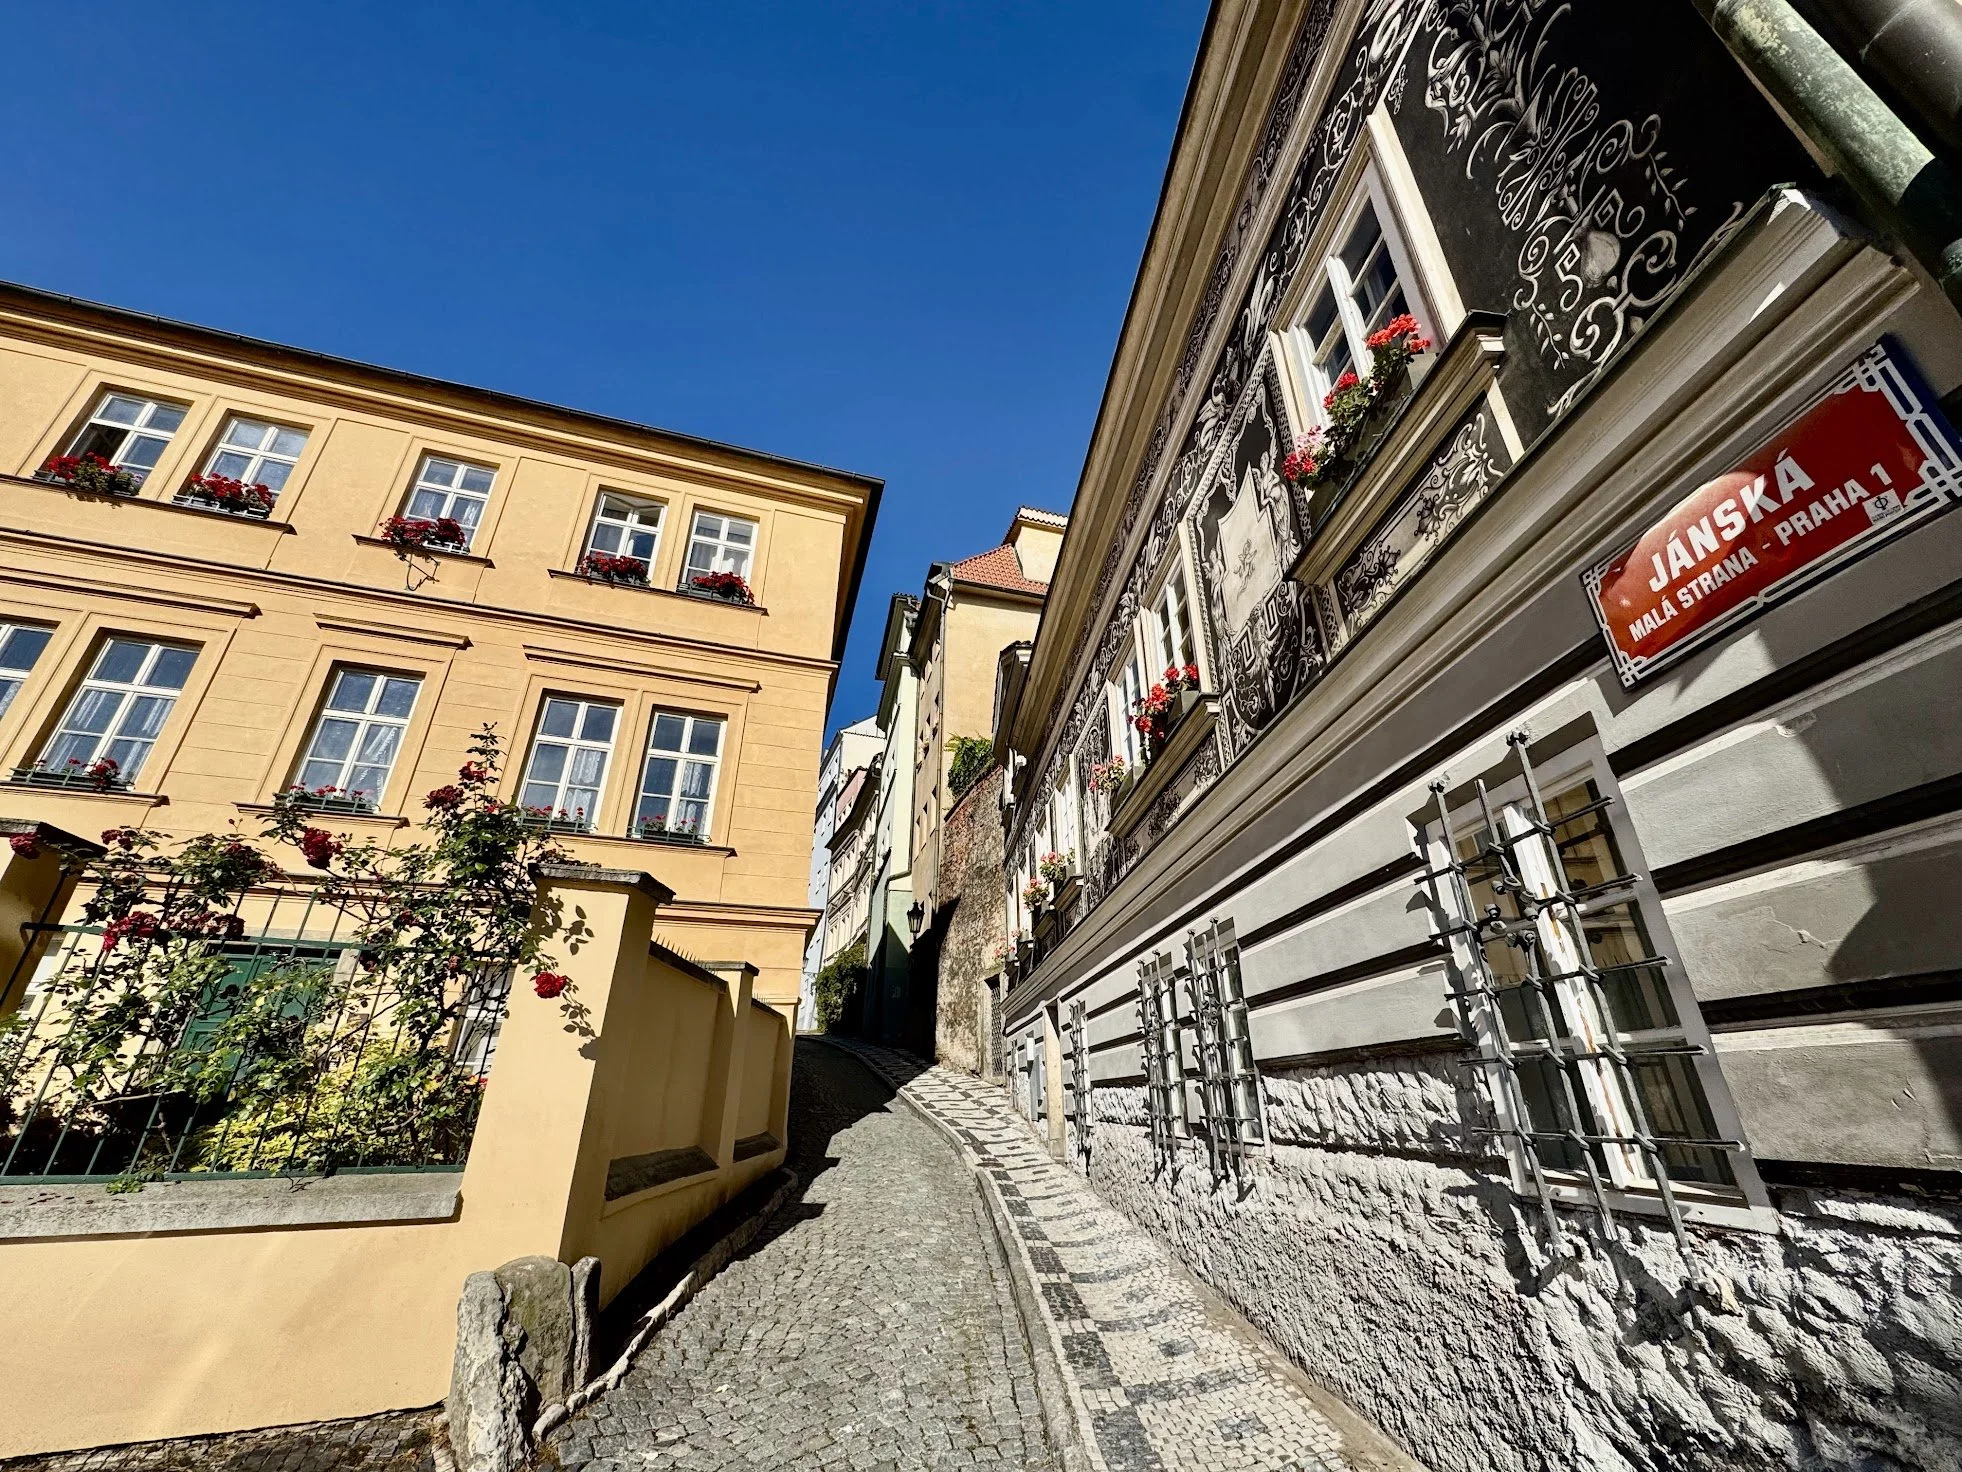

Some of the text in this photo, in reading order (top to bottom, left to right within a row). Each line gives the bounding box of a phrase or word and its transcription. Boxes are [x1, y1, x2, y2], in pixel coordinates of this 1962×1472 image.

[1628, 595, 1677, 643] MALÁ
[1681, 547, 1759, 610] STRANA
[1773, 478, 1871, 546] PRAHA
[1870, 462, 1893, 486] 1
[1648, 448, 1815, 593] JÁNSKÁ
